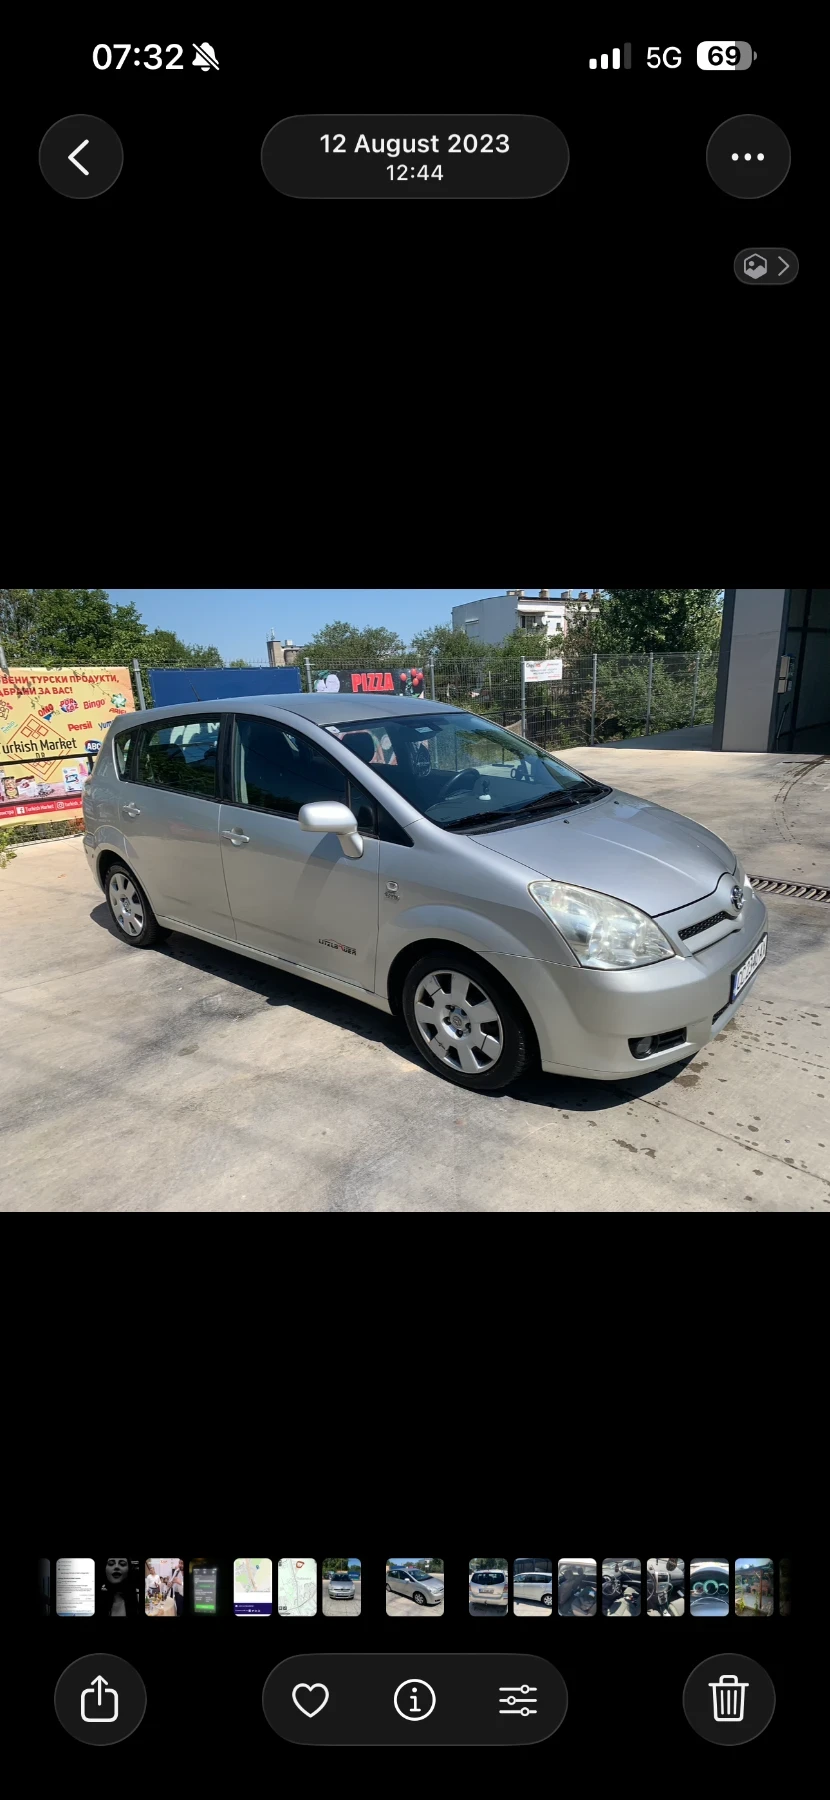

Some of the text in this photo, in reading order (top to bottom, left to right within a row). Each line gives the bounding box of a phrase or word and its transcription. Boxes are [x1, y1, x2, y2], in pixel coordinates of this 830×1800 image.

[0, 675, 119, 684] ВЕНИ ТУРСКИ ПРОДУКТИ,
[351, 672, 394, 692] PIZZA
[38, 687, 51, 695] ЗА
[52, 687, 73, 695] ВАС!
[83, 699, 106, 710] Bingo
[68, 721, 93, 732] Persil
[0, 738, 77, 754] urkish Market
